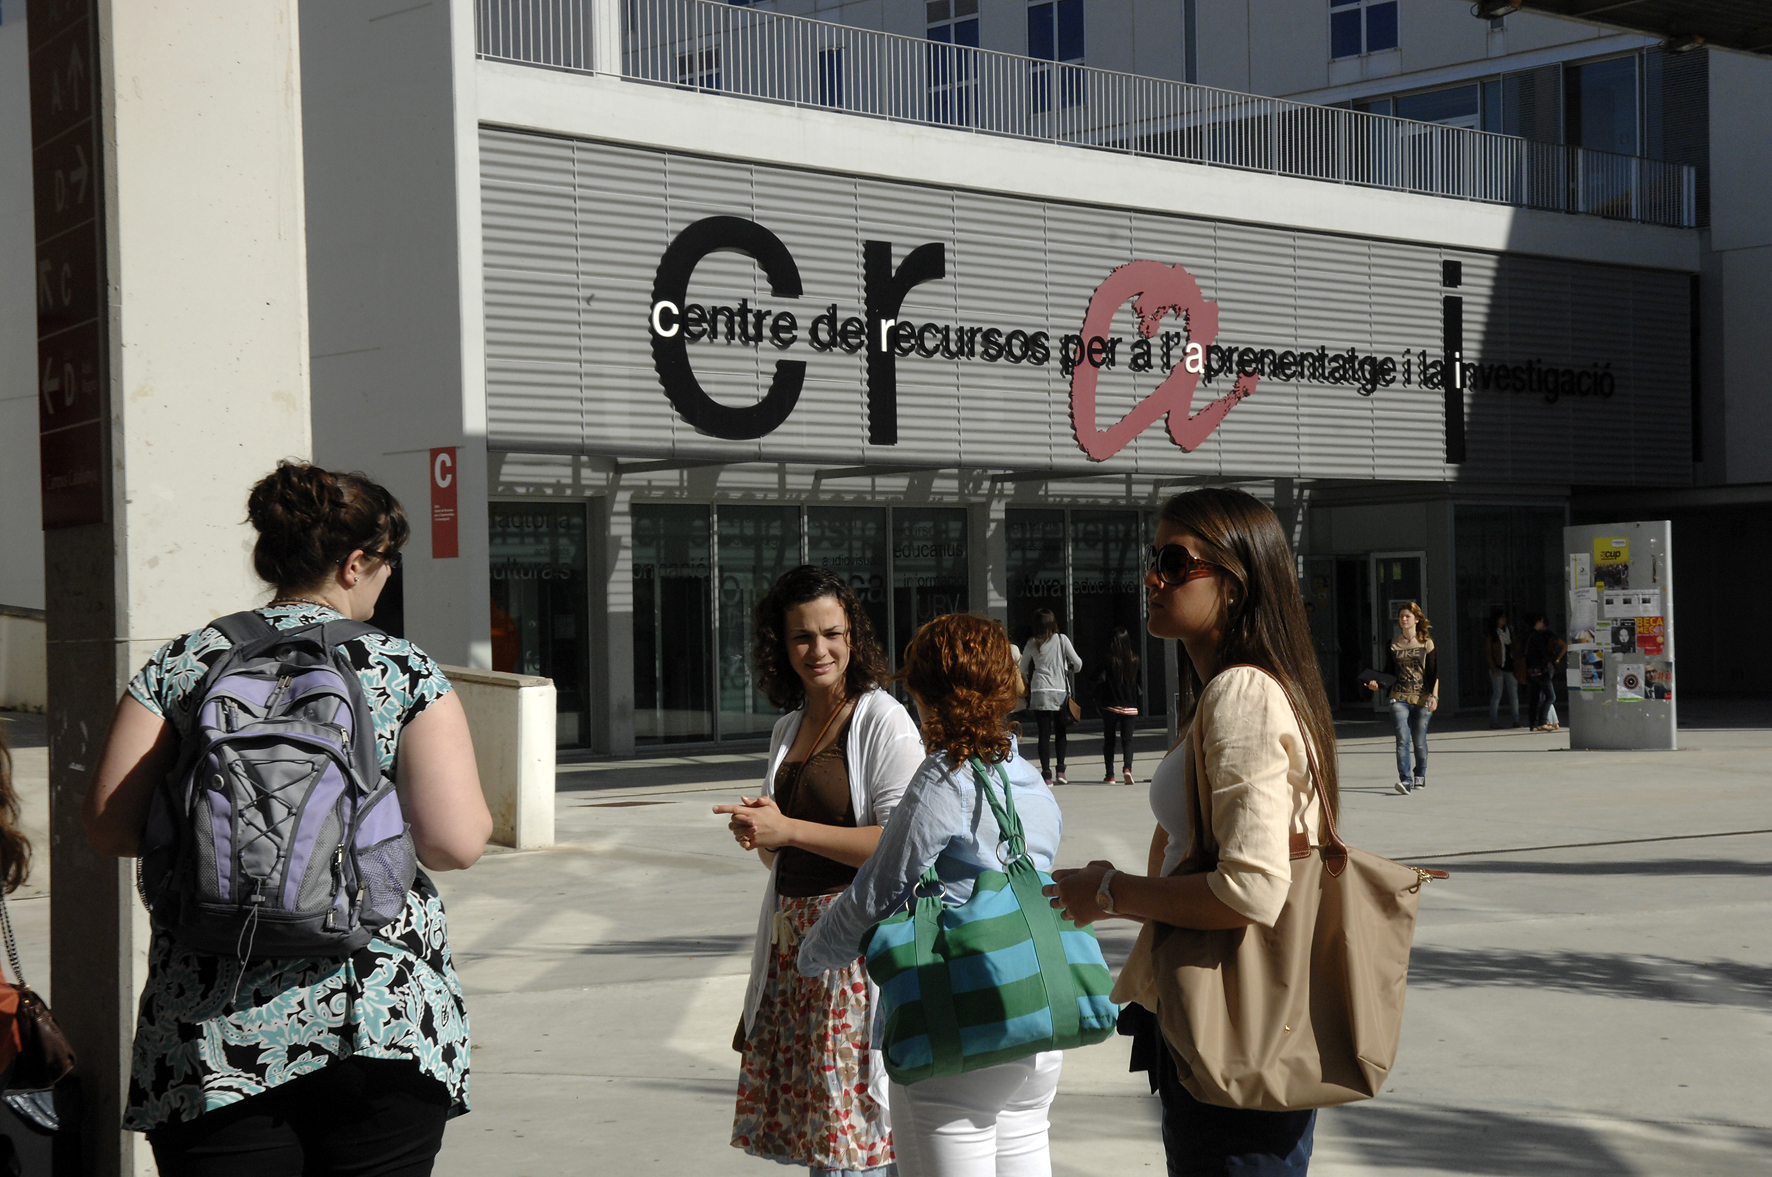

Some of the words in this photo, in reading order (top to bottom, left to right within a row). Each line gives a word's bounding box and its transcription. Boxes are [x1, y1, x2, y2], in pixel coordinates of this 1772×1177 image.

[652, 298, 799, 348] centre
[809, 303, 866, 353] de
[880, 317, 1051, 366] recursos
[1061, 332, 1123, 376] per
[1130, 336, 1154, 371] a
[1402, 348, 1412, 387] i
[1418, 349, 1445, 388] la
[1454, 351, 1616, 404] investigació
[434, 453, 453, 488] C
[1636, 617, 1664, 626] BECA
